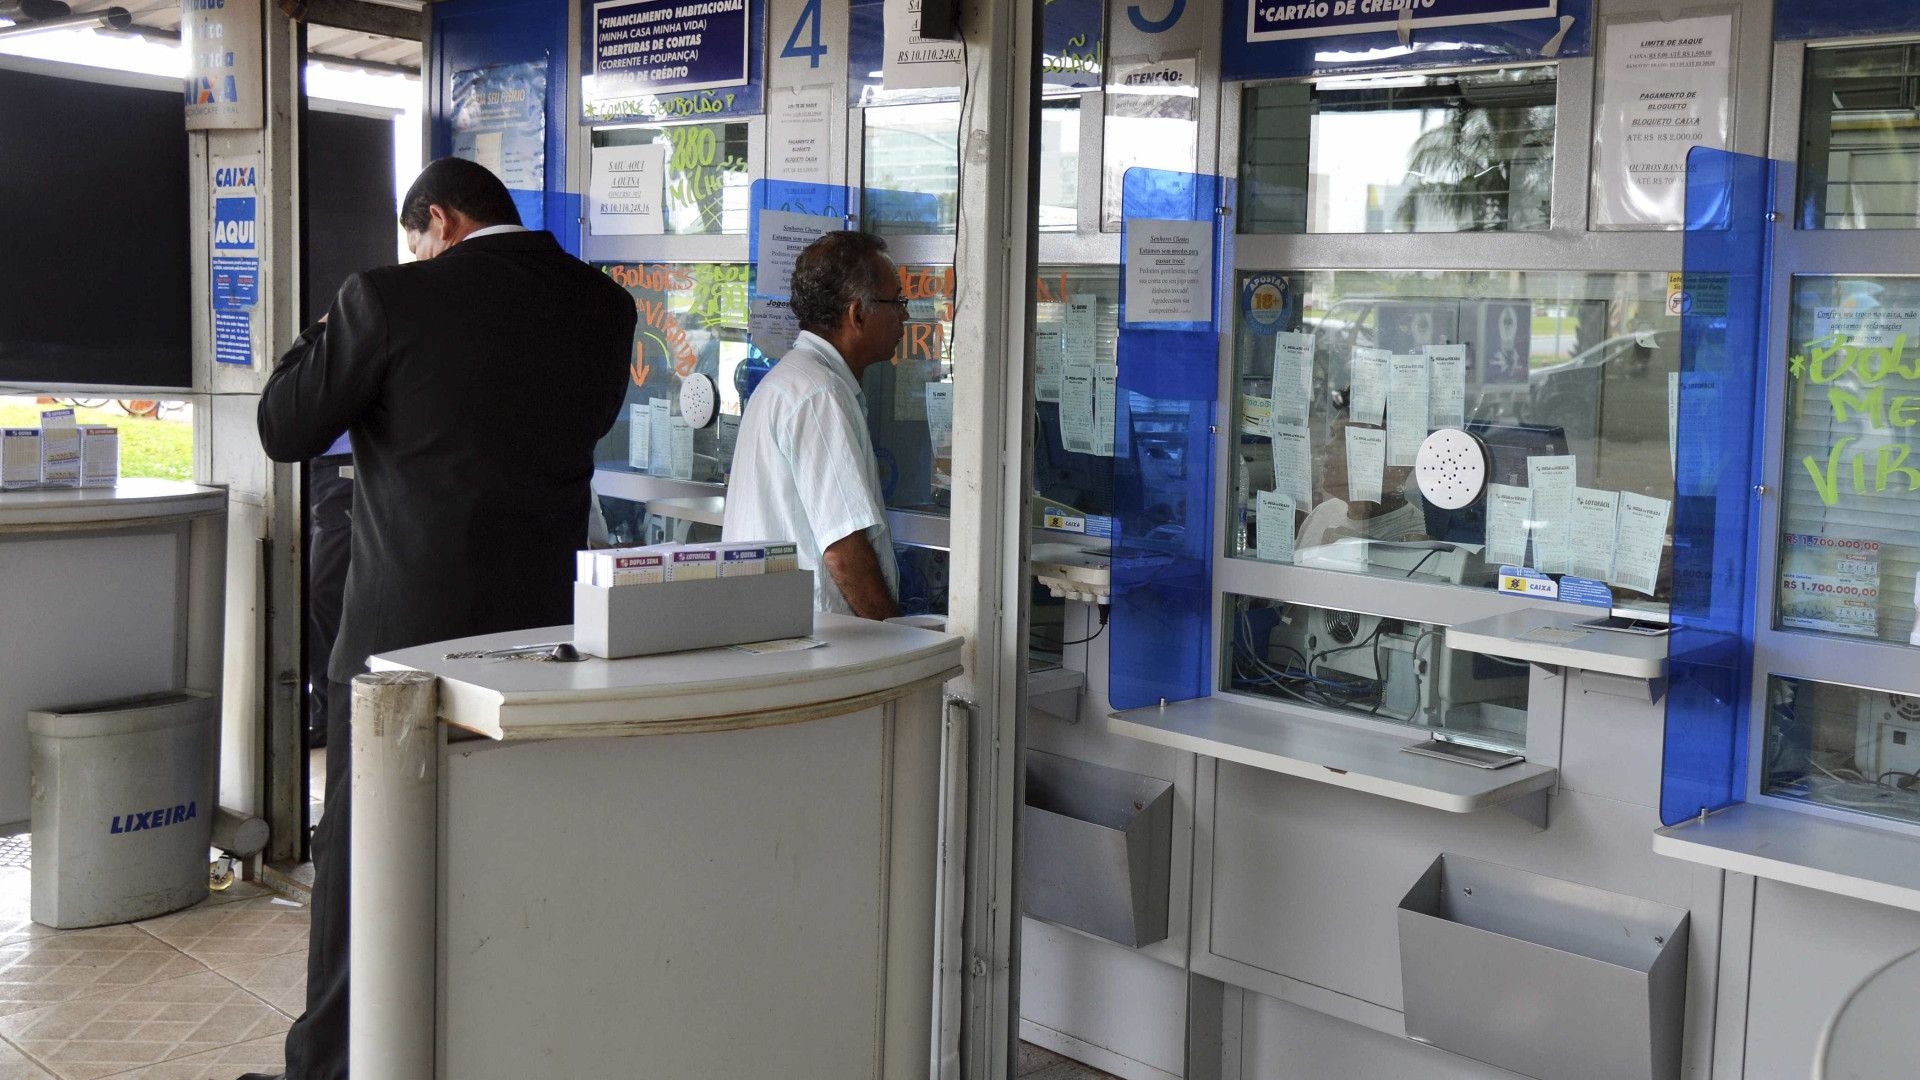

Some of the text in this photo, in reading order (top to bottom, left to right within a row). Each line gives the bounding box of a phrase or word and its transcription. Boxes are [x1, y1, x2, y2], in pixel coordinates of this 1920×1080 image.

[675, 0, 743, 18] HABITACIONAL
[1334, 1, 1355, 16] DE
[599, 19, 707, 43] (MINHA CASA MINHA VIDA)
[780, 0, 827, 68] 4
[652, 39, 664, 50] DE
[666, 34, 702, 48] CONTAS
[599, 49, 698, 71] (CORRENTE E POUPANÇA)
[911, 49, 961, 61] 10.110.248,1
[651, 65, 688, 80] CRÉDITO
[1631, 117, 1700, 126] BLOQUETO CAIXA
[1629, 163, 1661, 171] OUTROS
[215, 167, 256, 188] CAIXA
[215, 220, 255, 244] AQUI
[1785, 534, 1880, 551] R$ 1.700.000,00
[629, 559, 646, 567] DUPLA
[739, 551, 757, 559] QUINA
[1529, 583, 1552, 592] CAIXA
[1783, 580, 1878, 597] R$ 1.700.000,00
[110, 801, 197, 834] LIXEIRA
